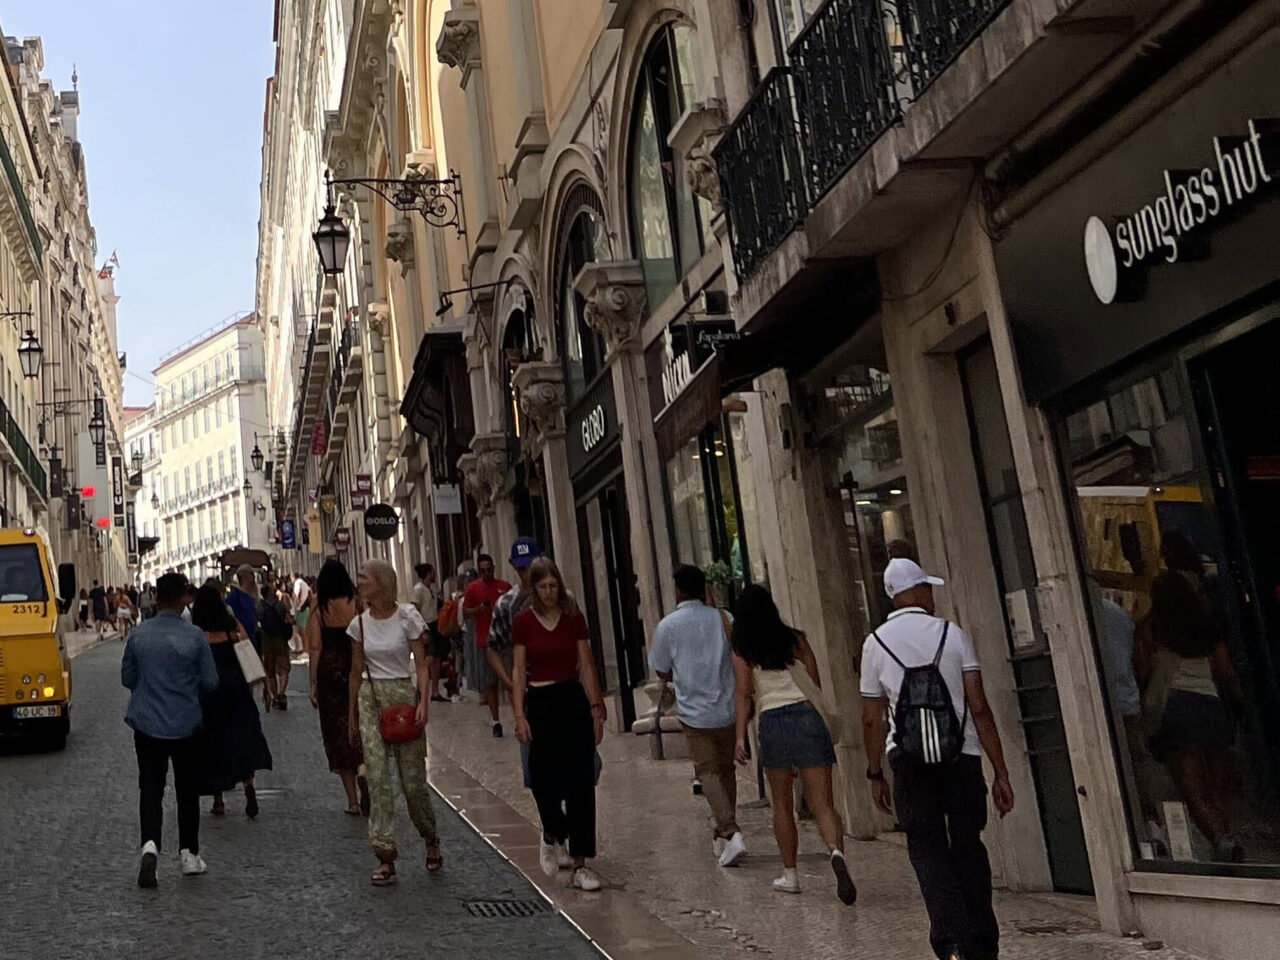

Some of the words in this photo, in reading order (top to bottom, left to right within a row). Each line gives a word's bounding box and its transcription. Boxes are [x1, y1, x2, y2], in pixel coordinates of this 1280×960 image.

[1116, 169, 1220, 268] sunglass
[1213, 118, 1271, 205] hut
[581, 404, 605, 452] GLOBO
[12, 605, 40, 614] 2312
